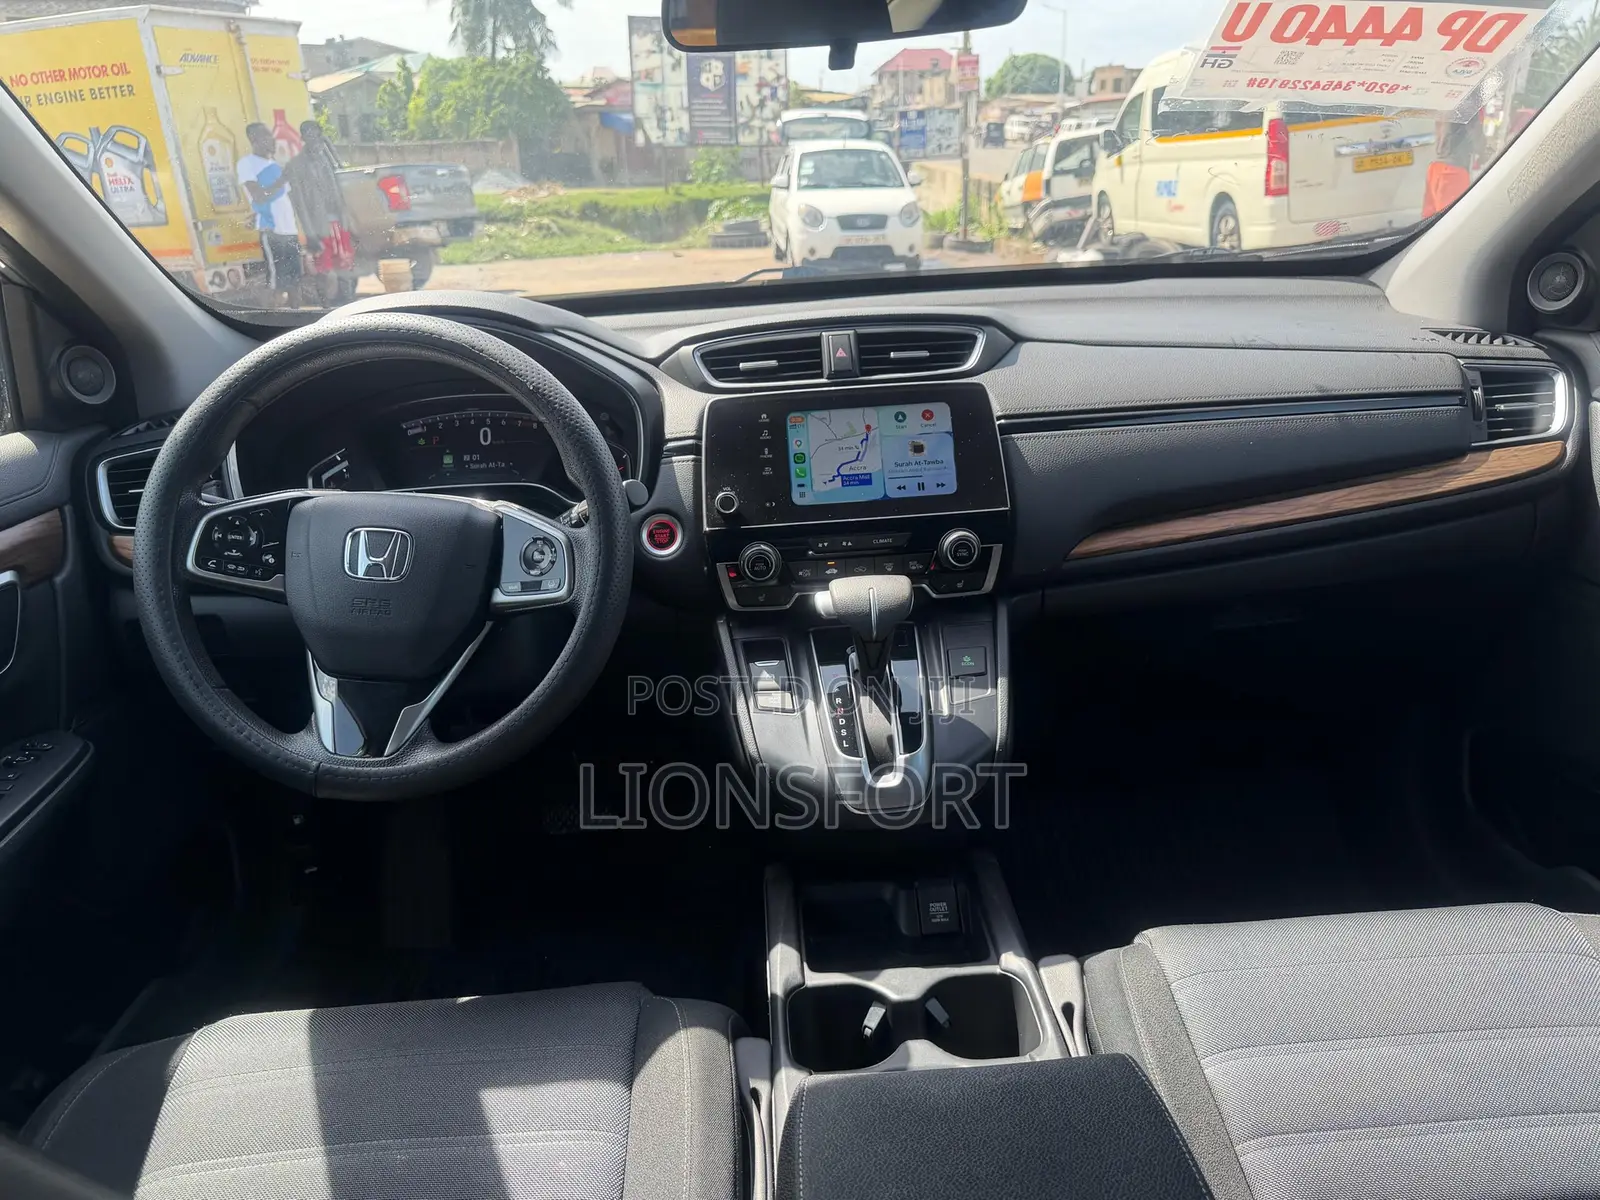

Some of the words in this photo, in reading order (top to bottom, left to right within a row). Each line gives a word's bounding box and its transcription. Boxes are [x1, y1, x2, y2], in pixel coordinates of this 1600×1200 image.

[180, 52, 220, 63] ADVANCE
[10, 74, 28, 87] NO
[30, 69, 67, 85] OTHER
[68, 64, 109, 81] MOTOR
[111, 62, 131, 76] OIL
[36, 89, 86, 106] ENGINE
[90, 84, 136, 100] BETTER
[108, 176, 134, 186] HELIX
[432, 436, 440, 446] P
[479, 427, 492, 446] 0
